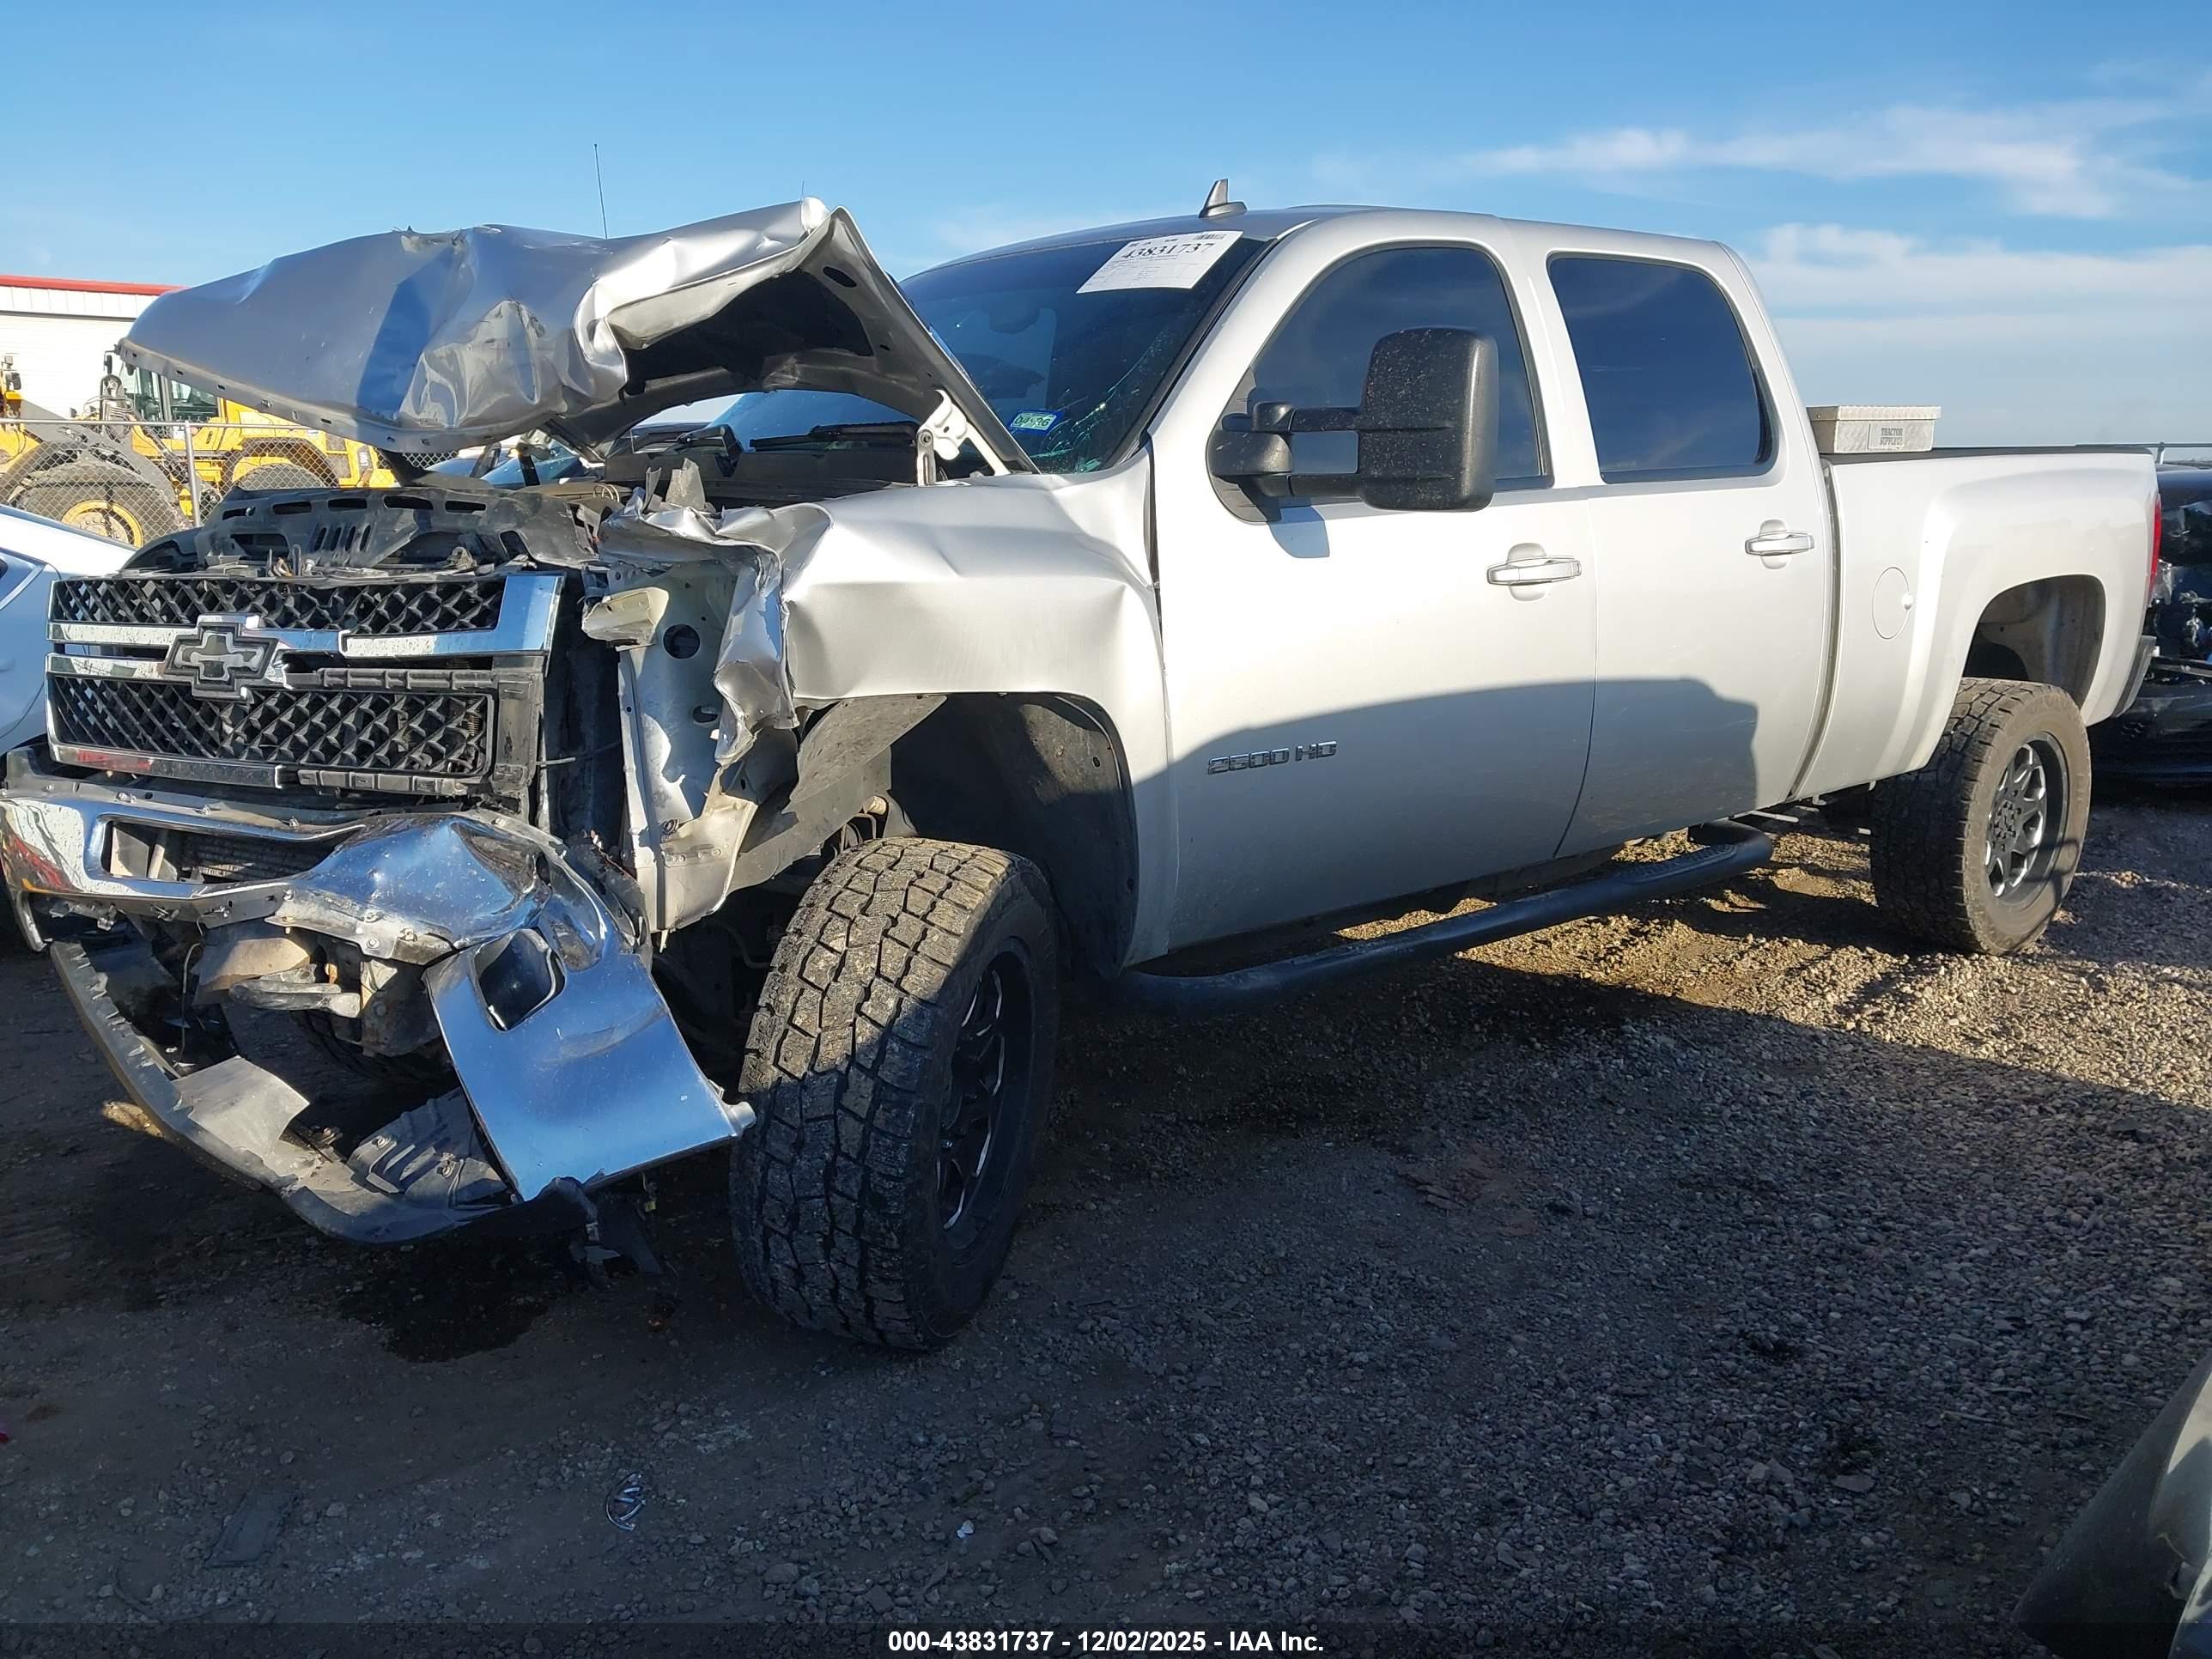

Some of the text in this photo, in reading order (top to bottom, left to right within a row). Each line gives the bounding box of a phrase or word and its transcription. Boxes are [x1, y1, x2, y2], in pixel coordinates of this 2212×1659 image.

[1120, 242, 1216, 259] 43831737
[1881, 428, 1903, 436] TRACTOR
[1207, 740, 1338, 775] 2500 HD
